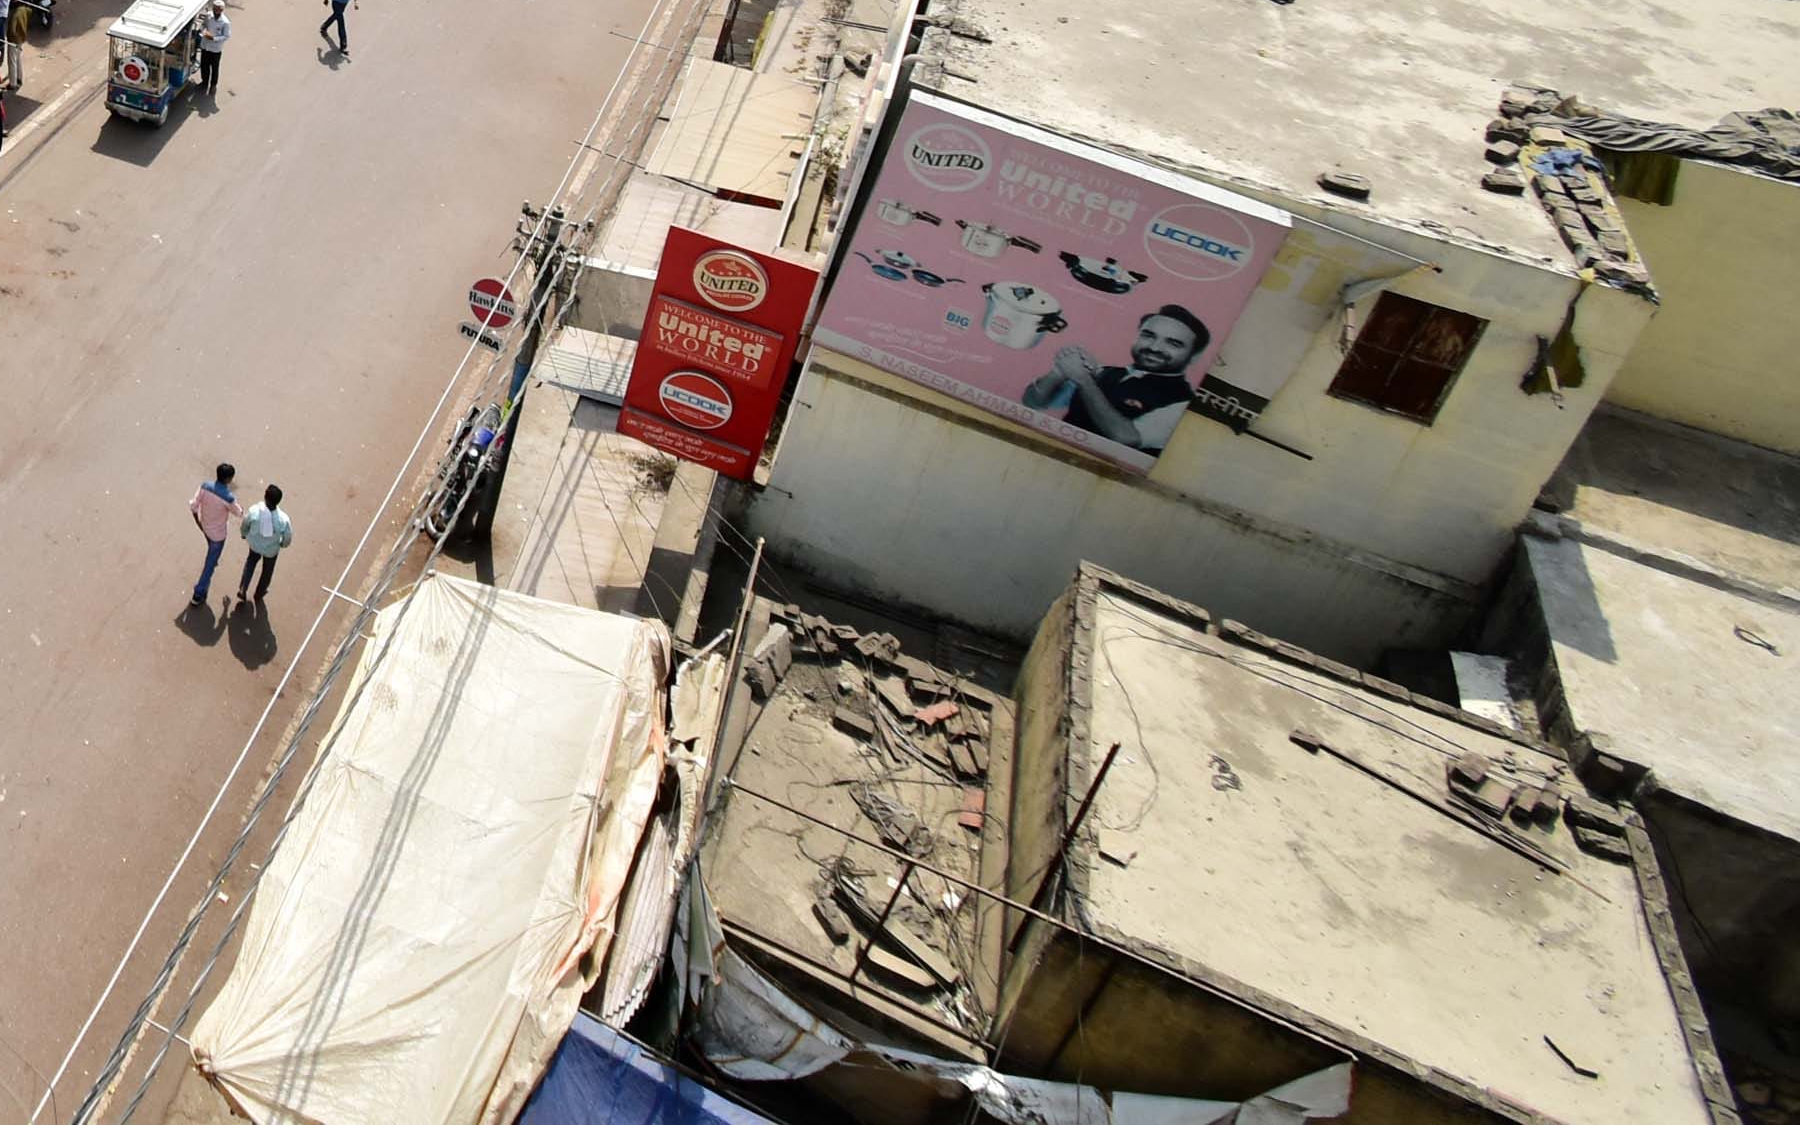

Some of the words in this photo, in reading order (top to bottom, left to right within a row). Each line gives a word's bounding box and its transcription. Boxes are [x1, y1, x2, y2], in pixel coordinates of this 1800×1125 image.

[911, 145, 984, 172] UNITED
[998, 182, 1128, 237] WORLD
[1151, 223, 1244, 261] UCOOK
[701, 274, 760, 295] UNITED
[663, 302, 722, 329] WELCOME
[724, 323, 741, 337] TO
[743, 328, 767, 344] THE
[946, 311, 969, 329] BIG
[461, 325, 499, 350] FUTURA
[659, 328, 760, 374] WORLD
[664, 385, 727, 415] UCOOK
[858, 346, 879, 362] S.
[881, 353, 959, 400] NASEEM
[963, 385, 1037, 425] AHMAD
